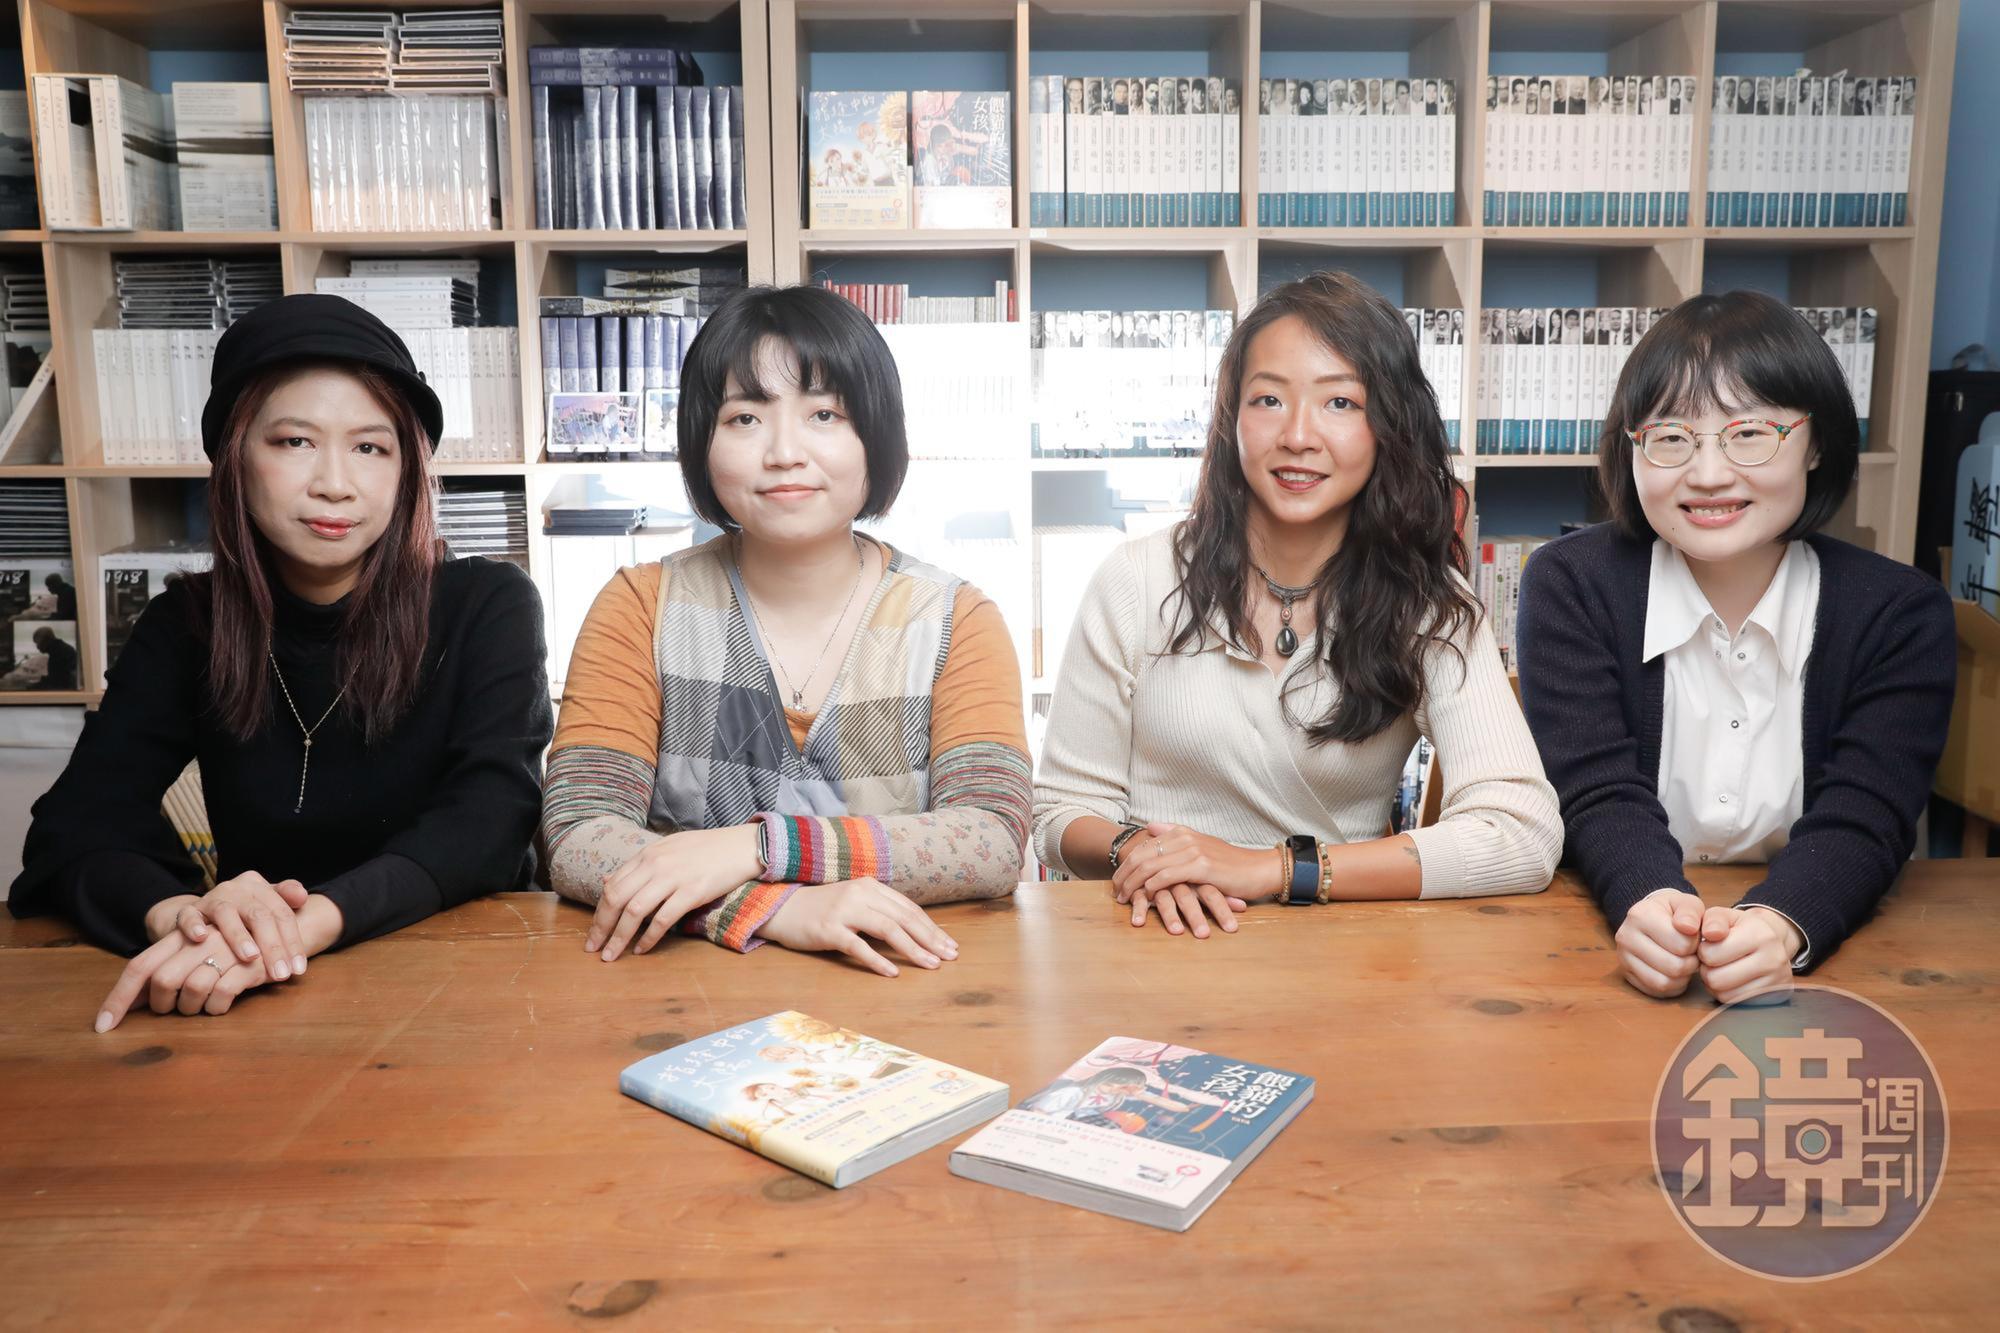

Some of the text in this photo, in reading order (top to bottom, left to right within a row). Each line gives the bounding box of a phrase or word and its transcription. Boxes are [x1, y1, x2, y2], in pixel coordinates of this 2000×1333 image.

[973, 96, 989, 130] 女孩
[1201, 1064, 1257, 1096] 女孩
[1222, 1071, 1296, 1119] 餵貓的
